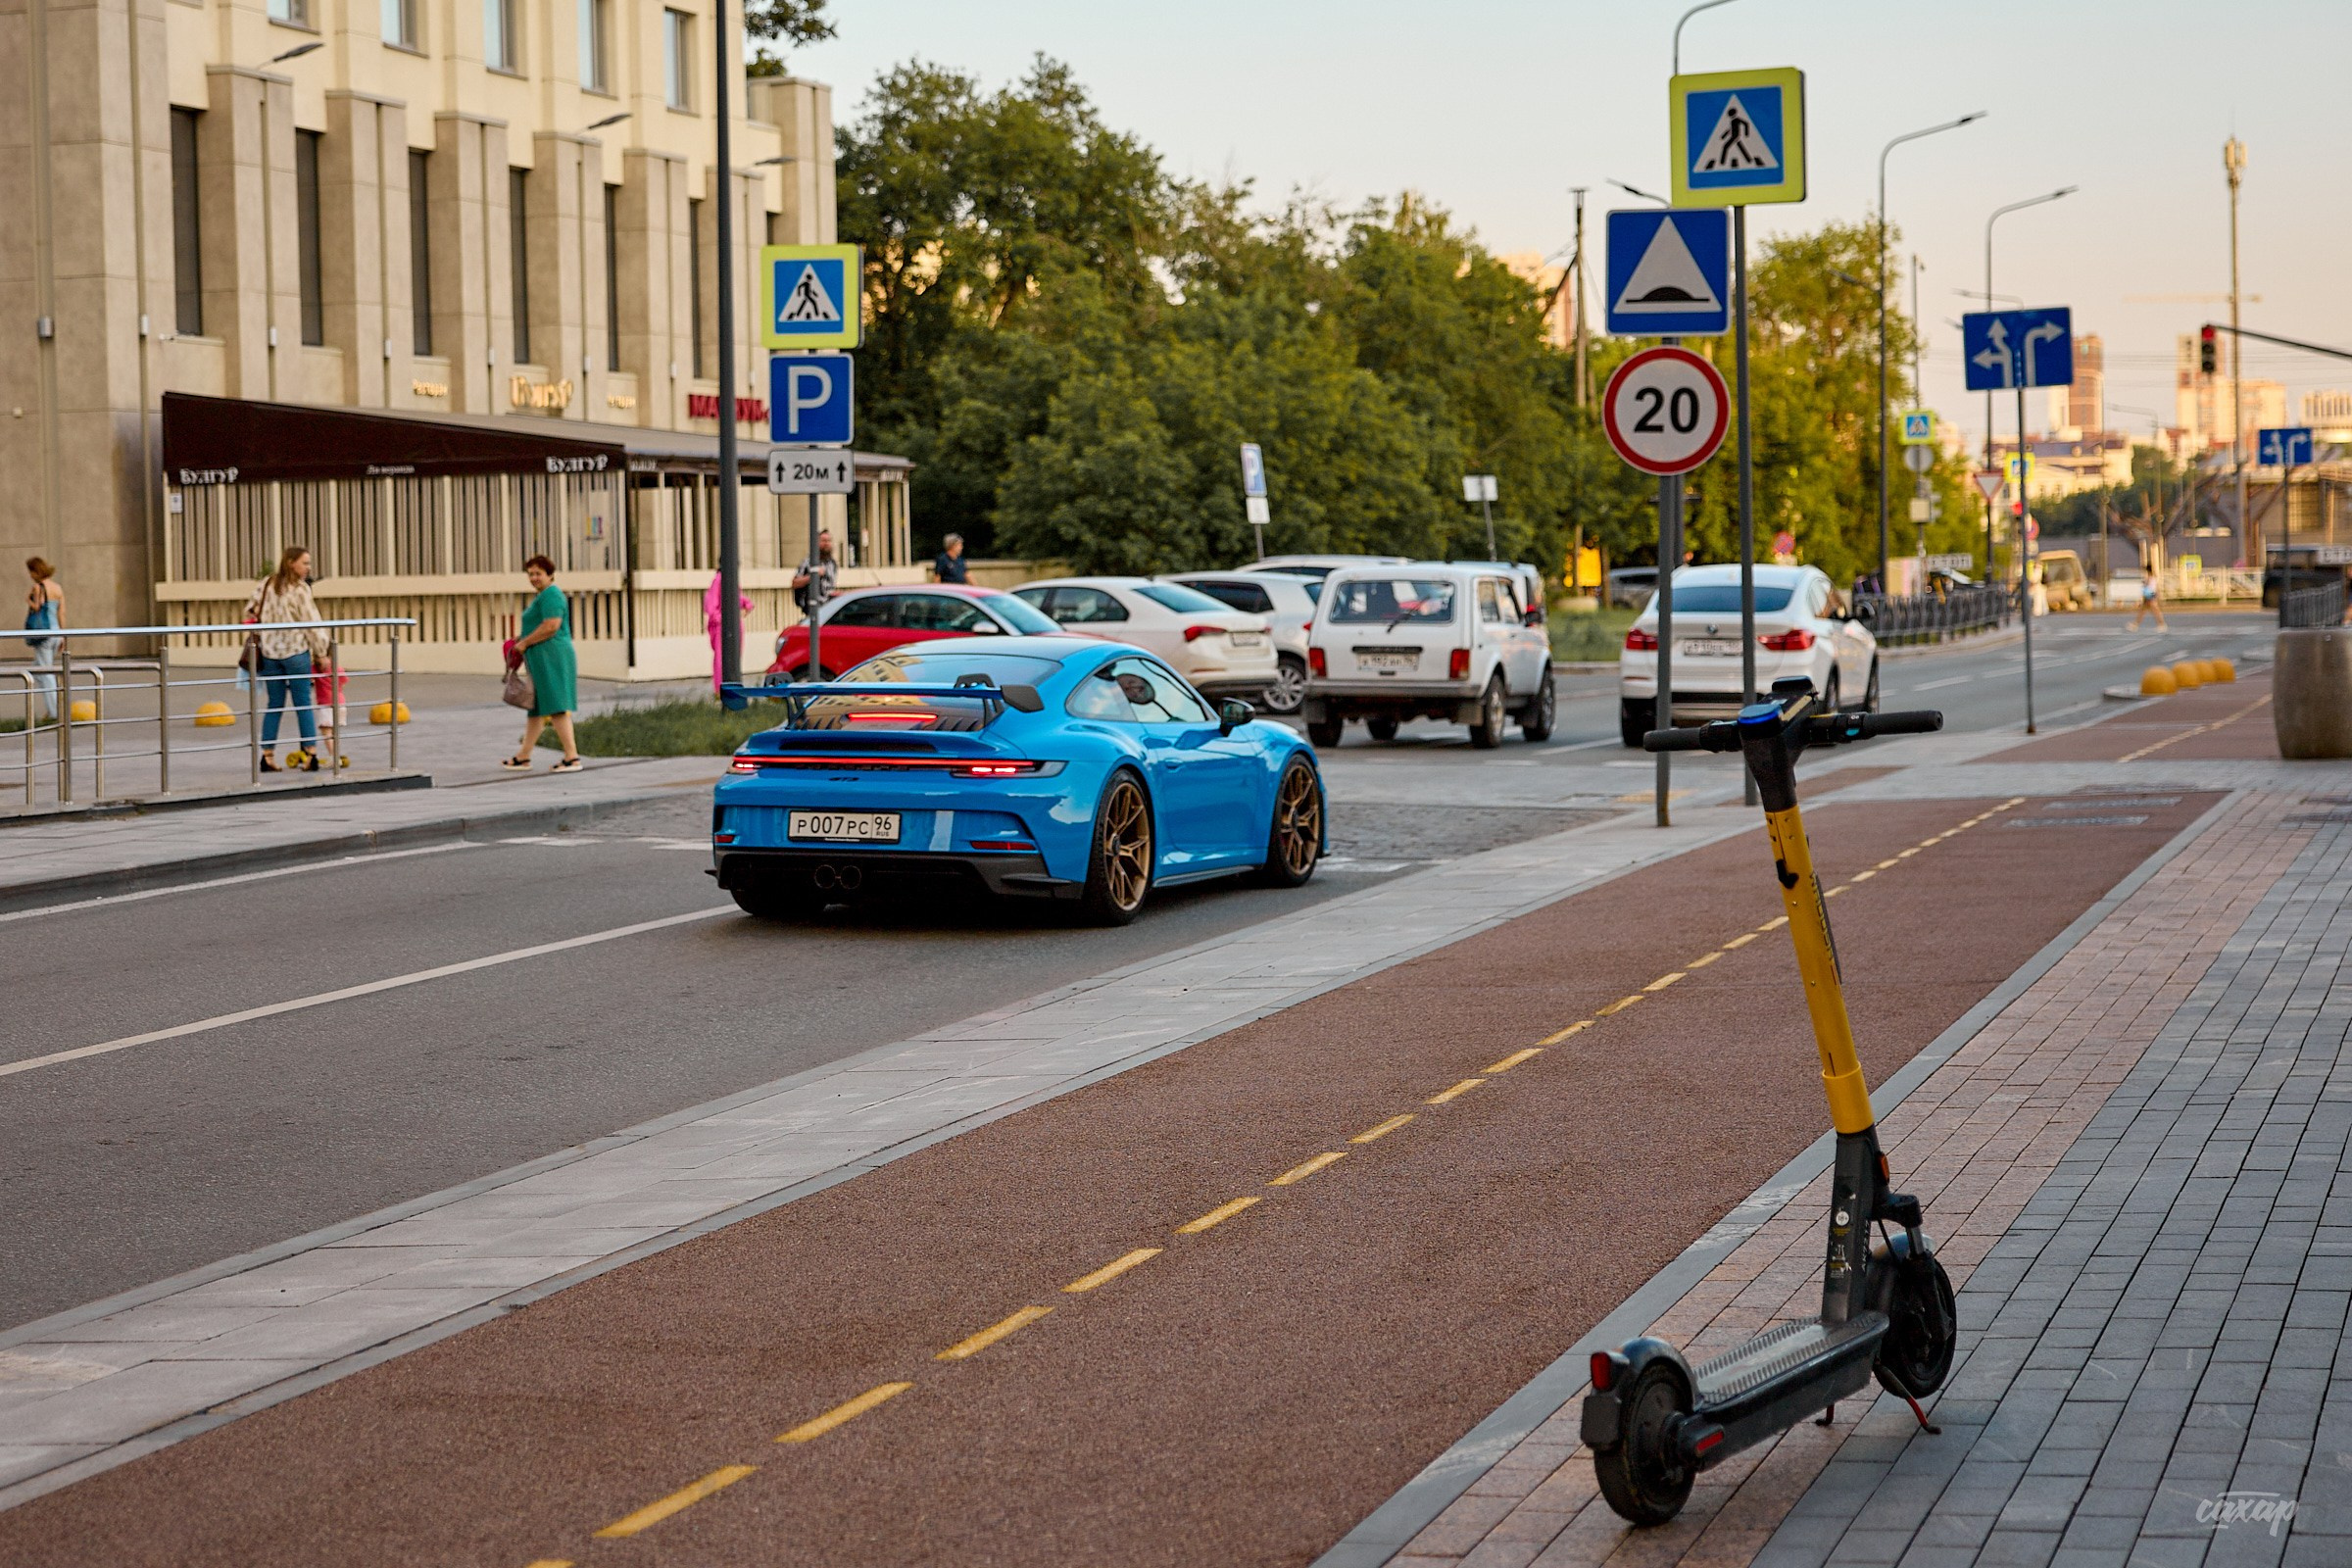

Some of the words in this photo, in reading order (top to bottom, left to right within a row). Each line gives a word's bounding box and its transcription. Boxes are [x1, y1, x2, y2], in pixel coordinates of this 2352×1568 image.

[788, 365, 832, 434] P
[1635, 387, 1700, 434] 20
[874, 816, 892, 831] 96
